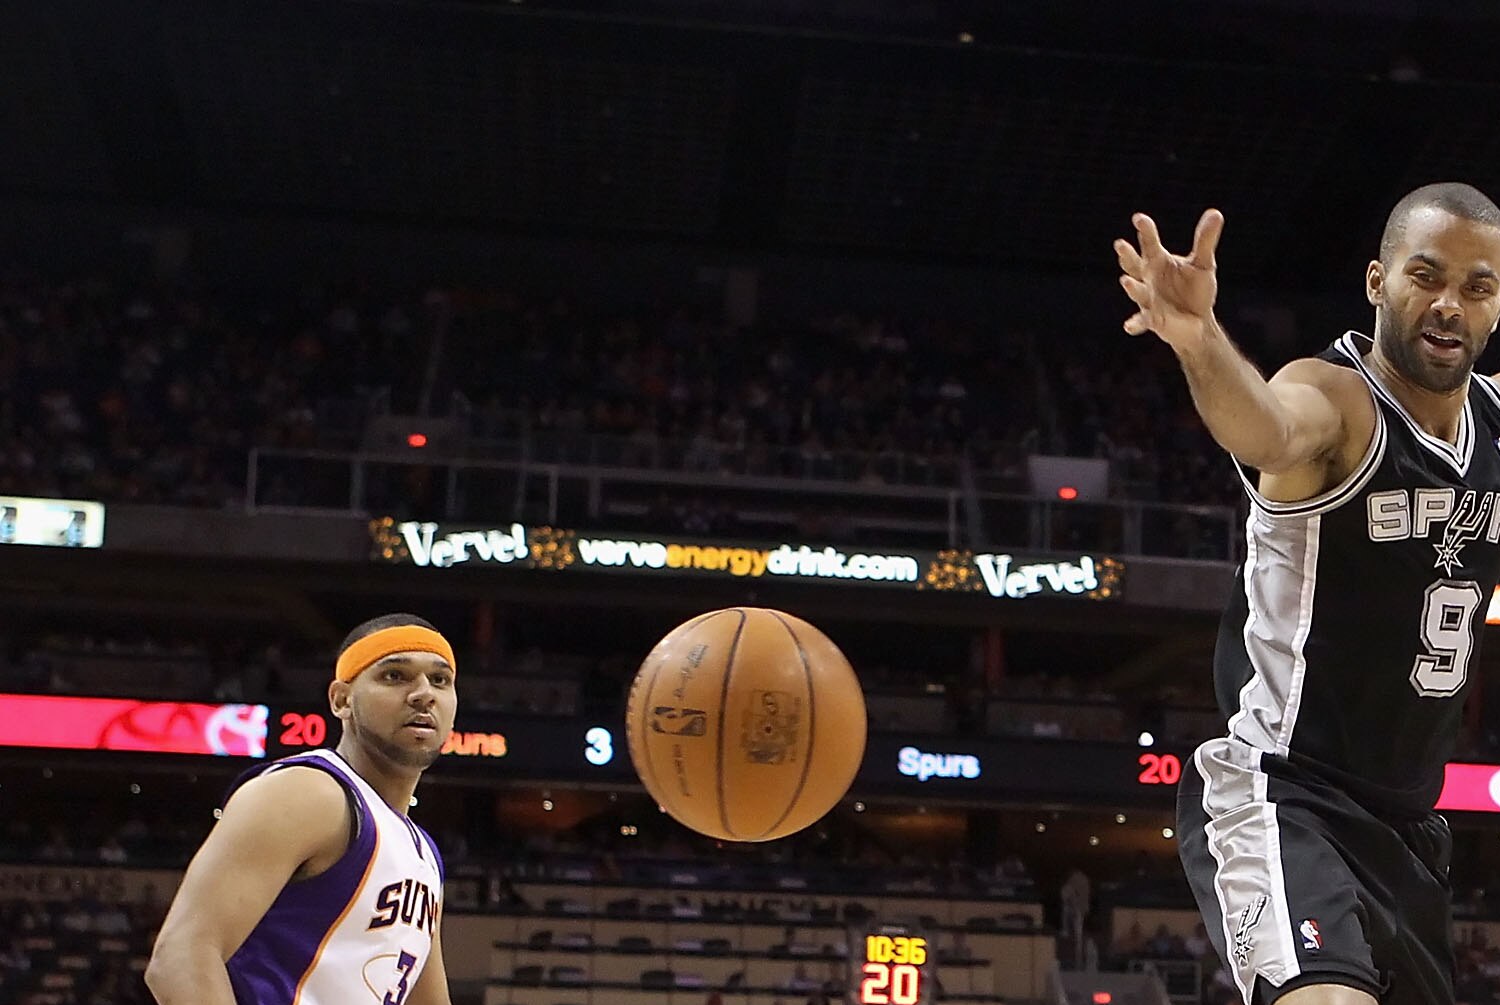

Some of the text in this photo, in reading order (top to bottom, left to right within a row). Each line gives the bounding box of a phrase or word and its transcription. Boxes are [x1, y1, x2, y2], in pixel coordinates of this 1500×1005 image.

[399, 521, 529, 568] Verve!
[578, 538, 918, 582] verveenergydrink.com
[974, 553, 1098, 598] Verve!
[1409, 578, 1482, 698] 9
[280, 713, 327, 746] 20
[584, 727, 614, 766] 3
[898, 747, 982, 782] Spurs
[1138, 754, 1181, 785] 20
[366, 878, 438, 938] SUN
